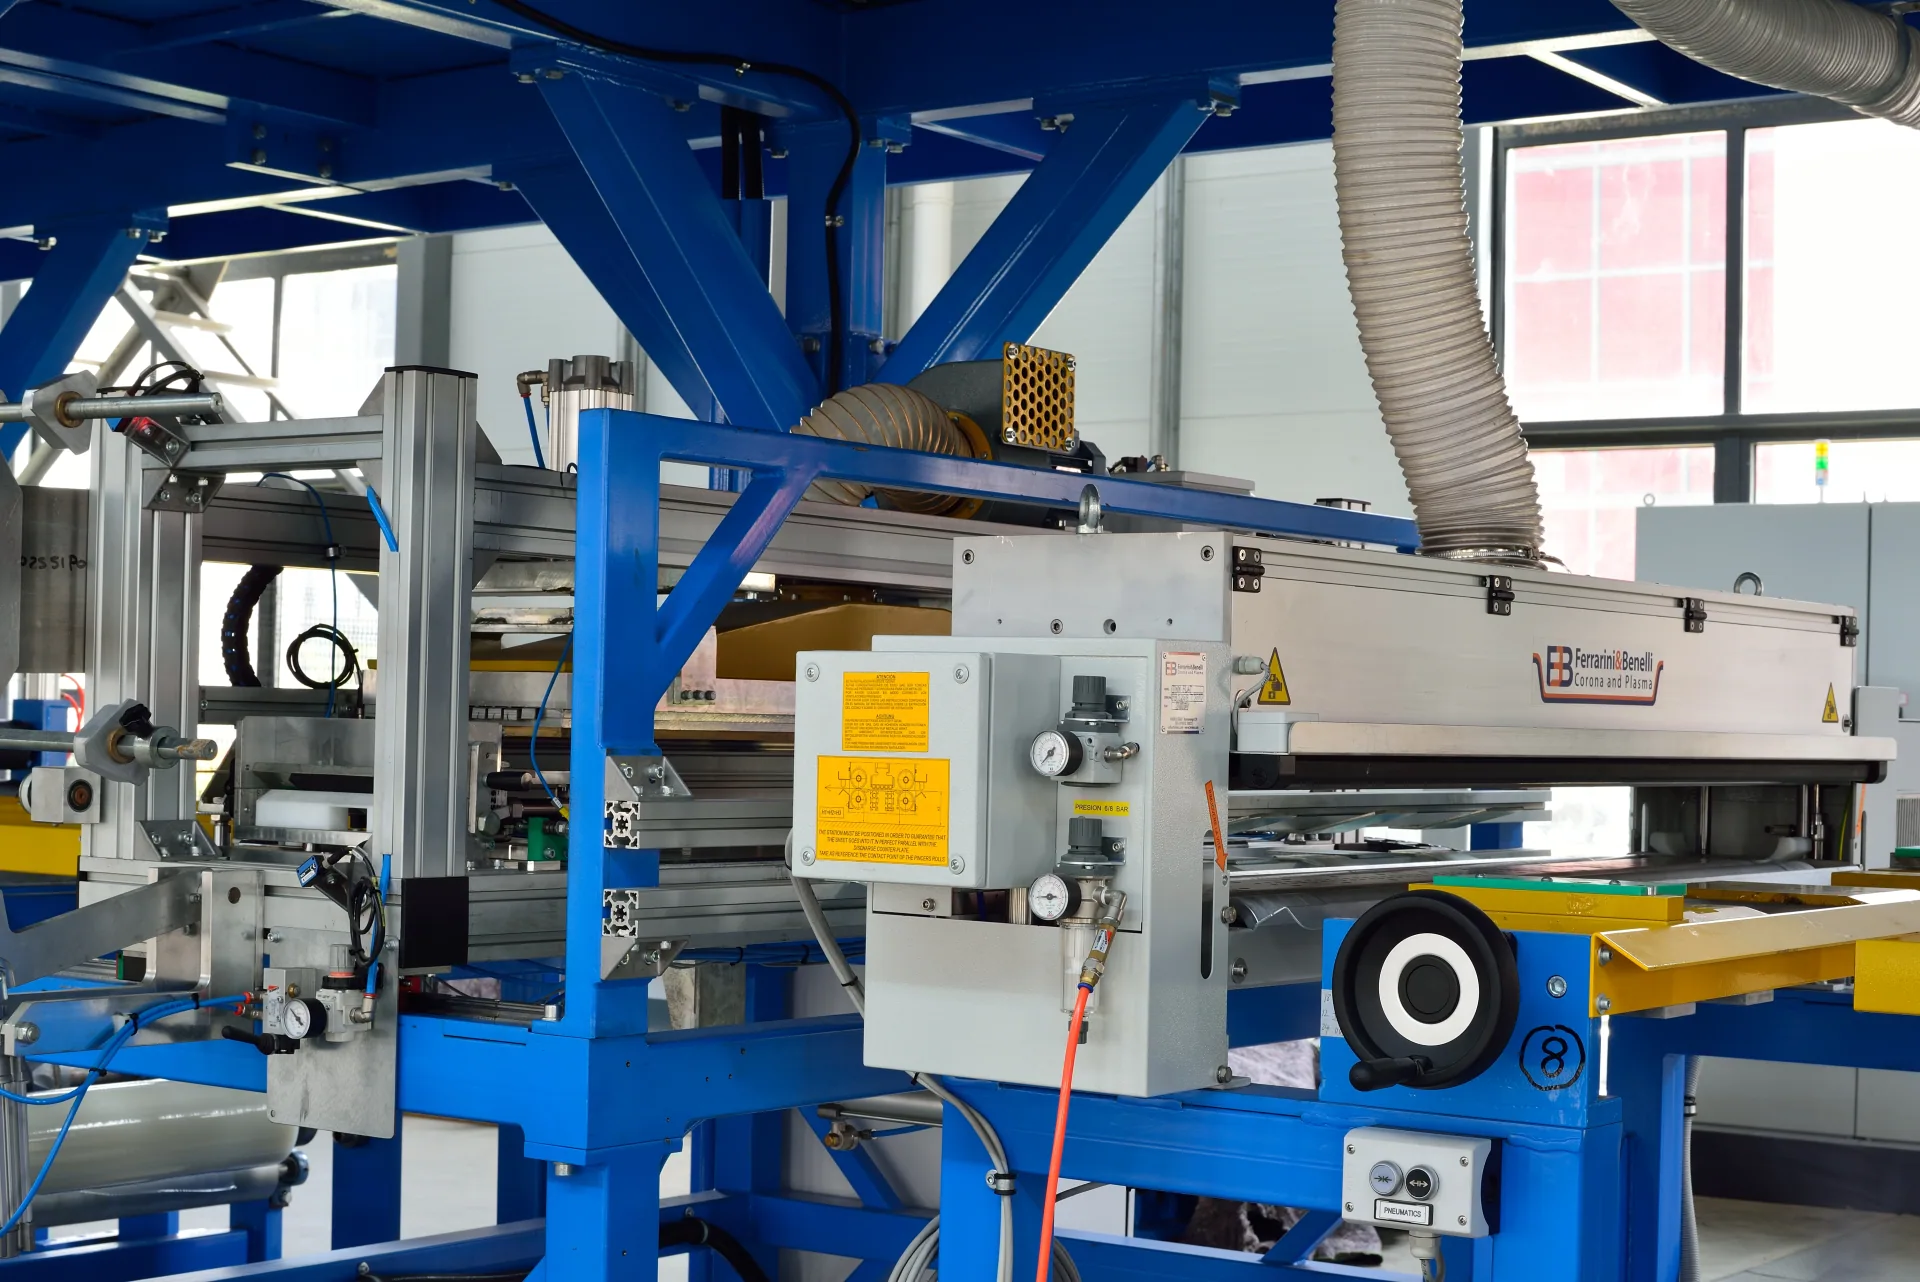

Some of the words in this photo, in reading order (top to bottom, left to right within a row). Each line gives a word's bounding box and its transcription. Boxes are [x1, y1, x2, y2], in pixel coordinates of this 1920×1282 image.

[1575, 648, 1653, 672] Ferrarini&Benelli
[1575, 673, 1604, 688] Corona
[1608, 674, 1622, 689] and
[1625, 675, 1653, 690] Plasma
[1116, 805, 1129, 813] BAR
[1540, 1035, 1569, 1079] 8
[1383, 1206, 1422, 1218] PNEUMATICS
